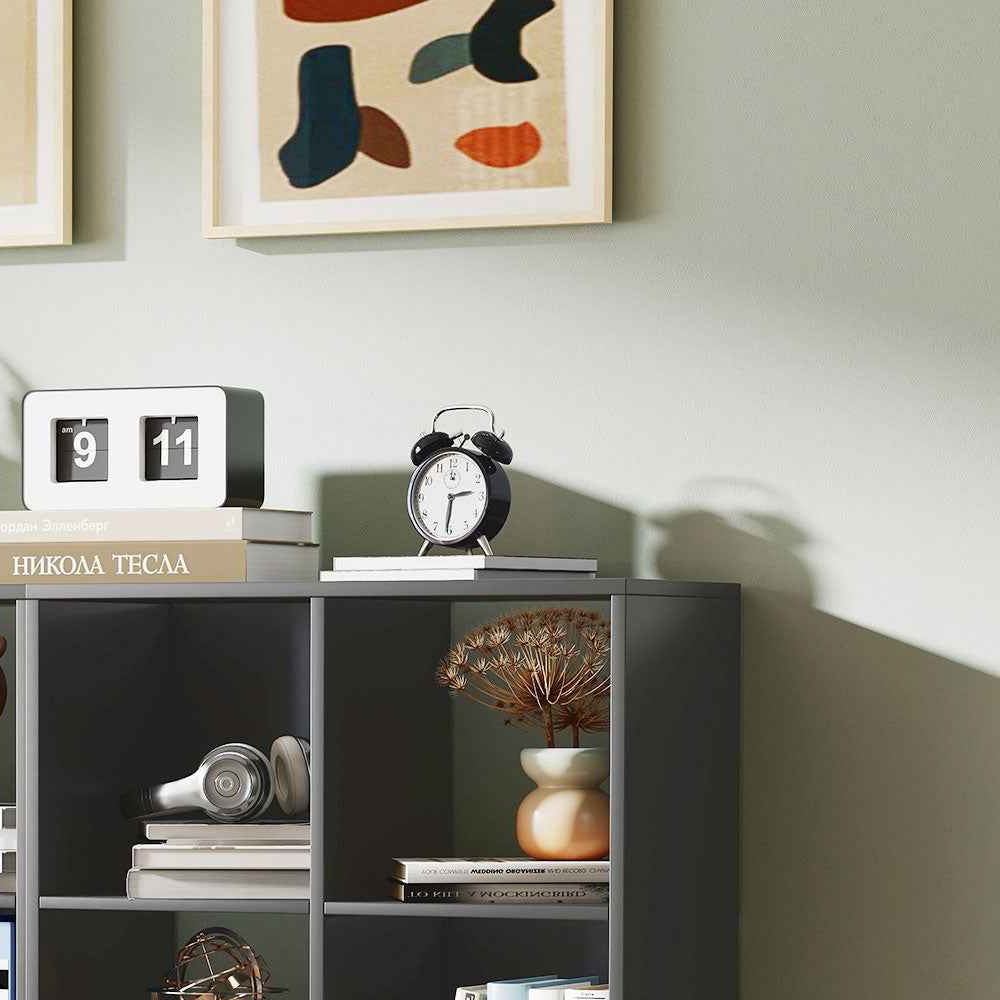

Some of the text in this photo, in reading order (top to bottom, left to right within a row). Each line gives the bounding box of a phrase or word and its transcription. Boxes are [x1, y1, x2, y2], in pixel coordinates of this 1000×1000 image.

[73, 428, 192, 468] 9 11
[12, 553, 190, 576] НИКОЛА ТЕСЛА
